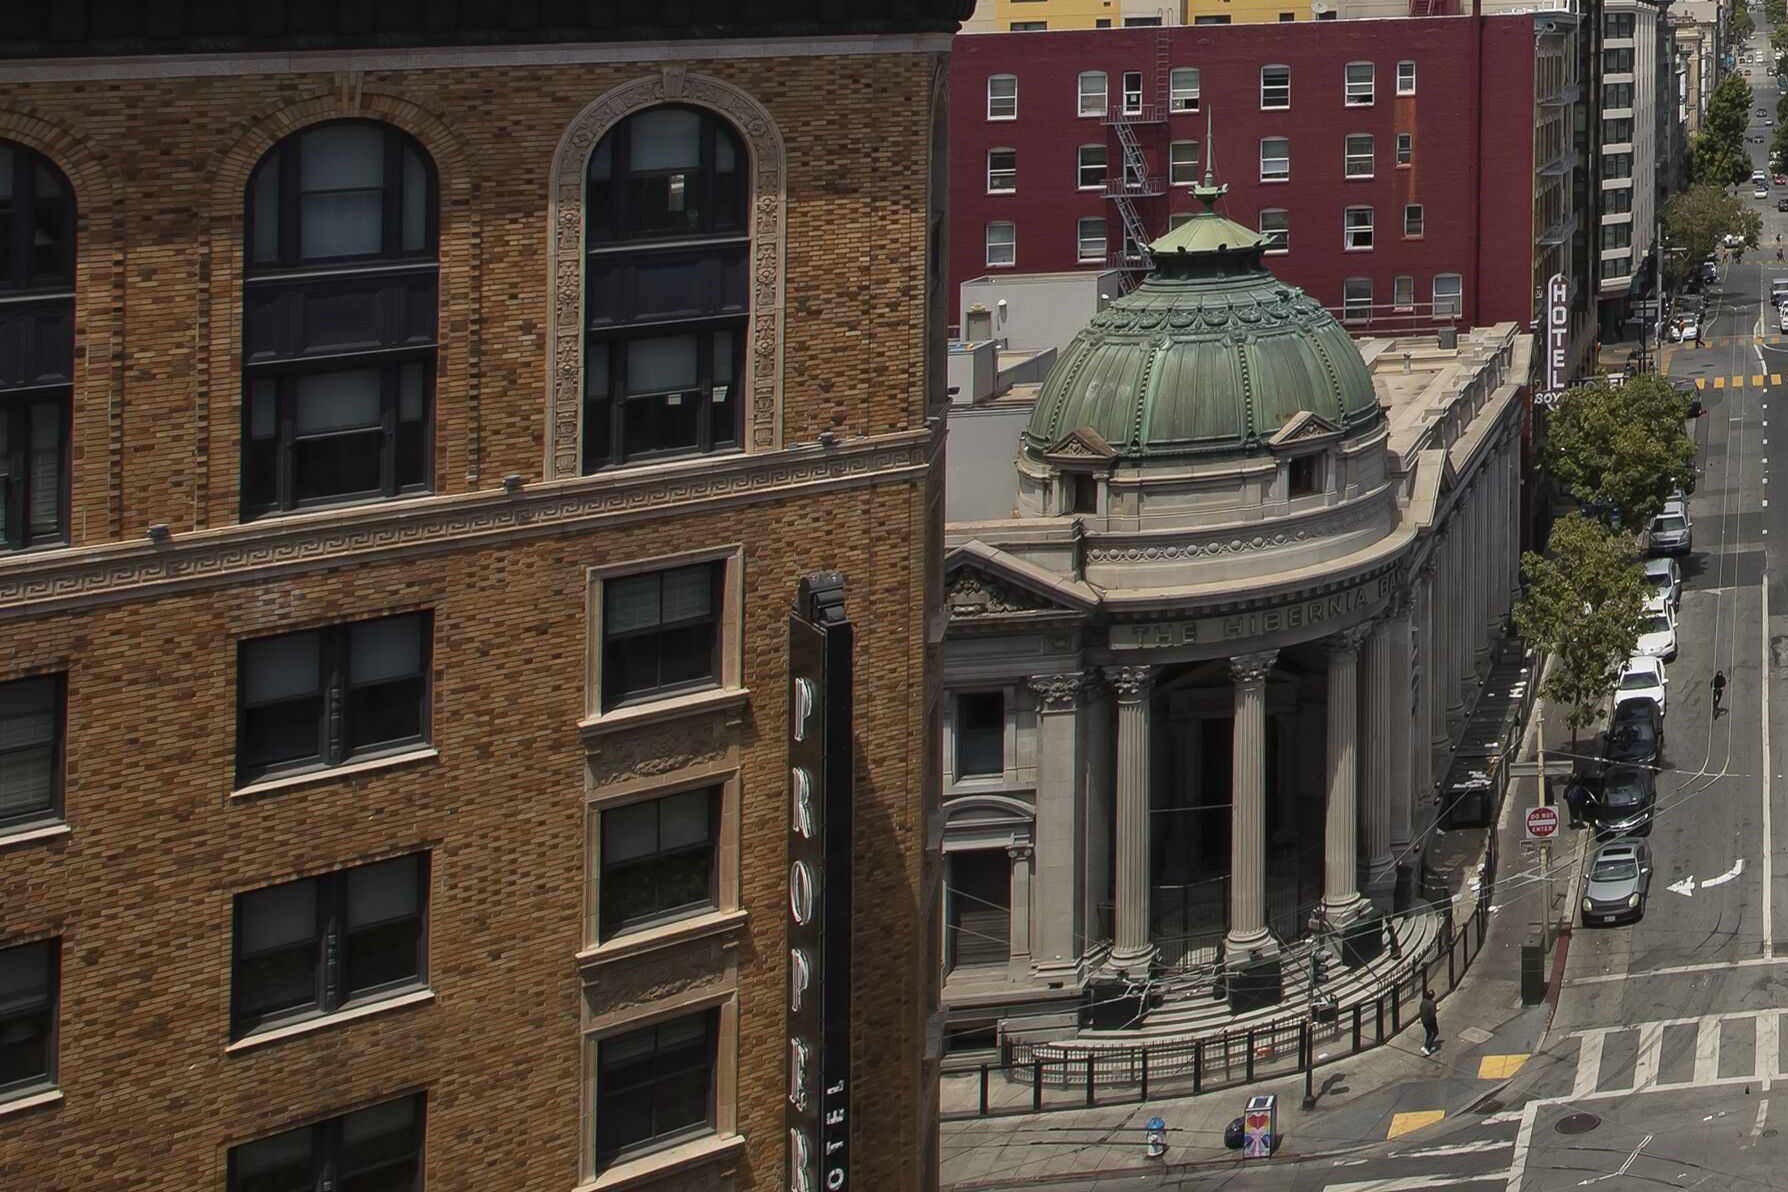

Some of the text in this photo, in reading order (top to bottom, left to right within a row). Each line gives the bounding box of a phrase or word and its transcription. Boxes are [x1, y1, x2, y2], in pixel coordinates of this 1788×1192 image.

[1552, 284, 1567, 389] HOTEL
[1132, 624, 1197, 648] THE
[1224, 587, 1368, 640] HIBERNIA
[789, 677, 814, 1192] PROPER
[826, 1079, 844, 1191] OTEL
